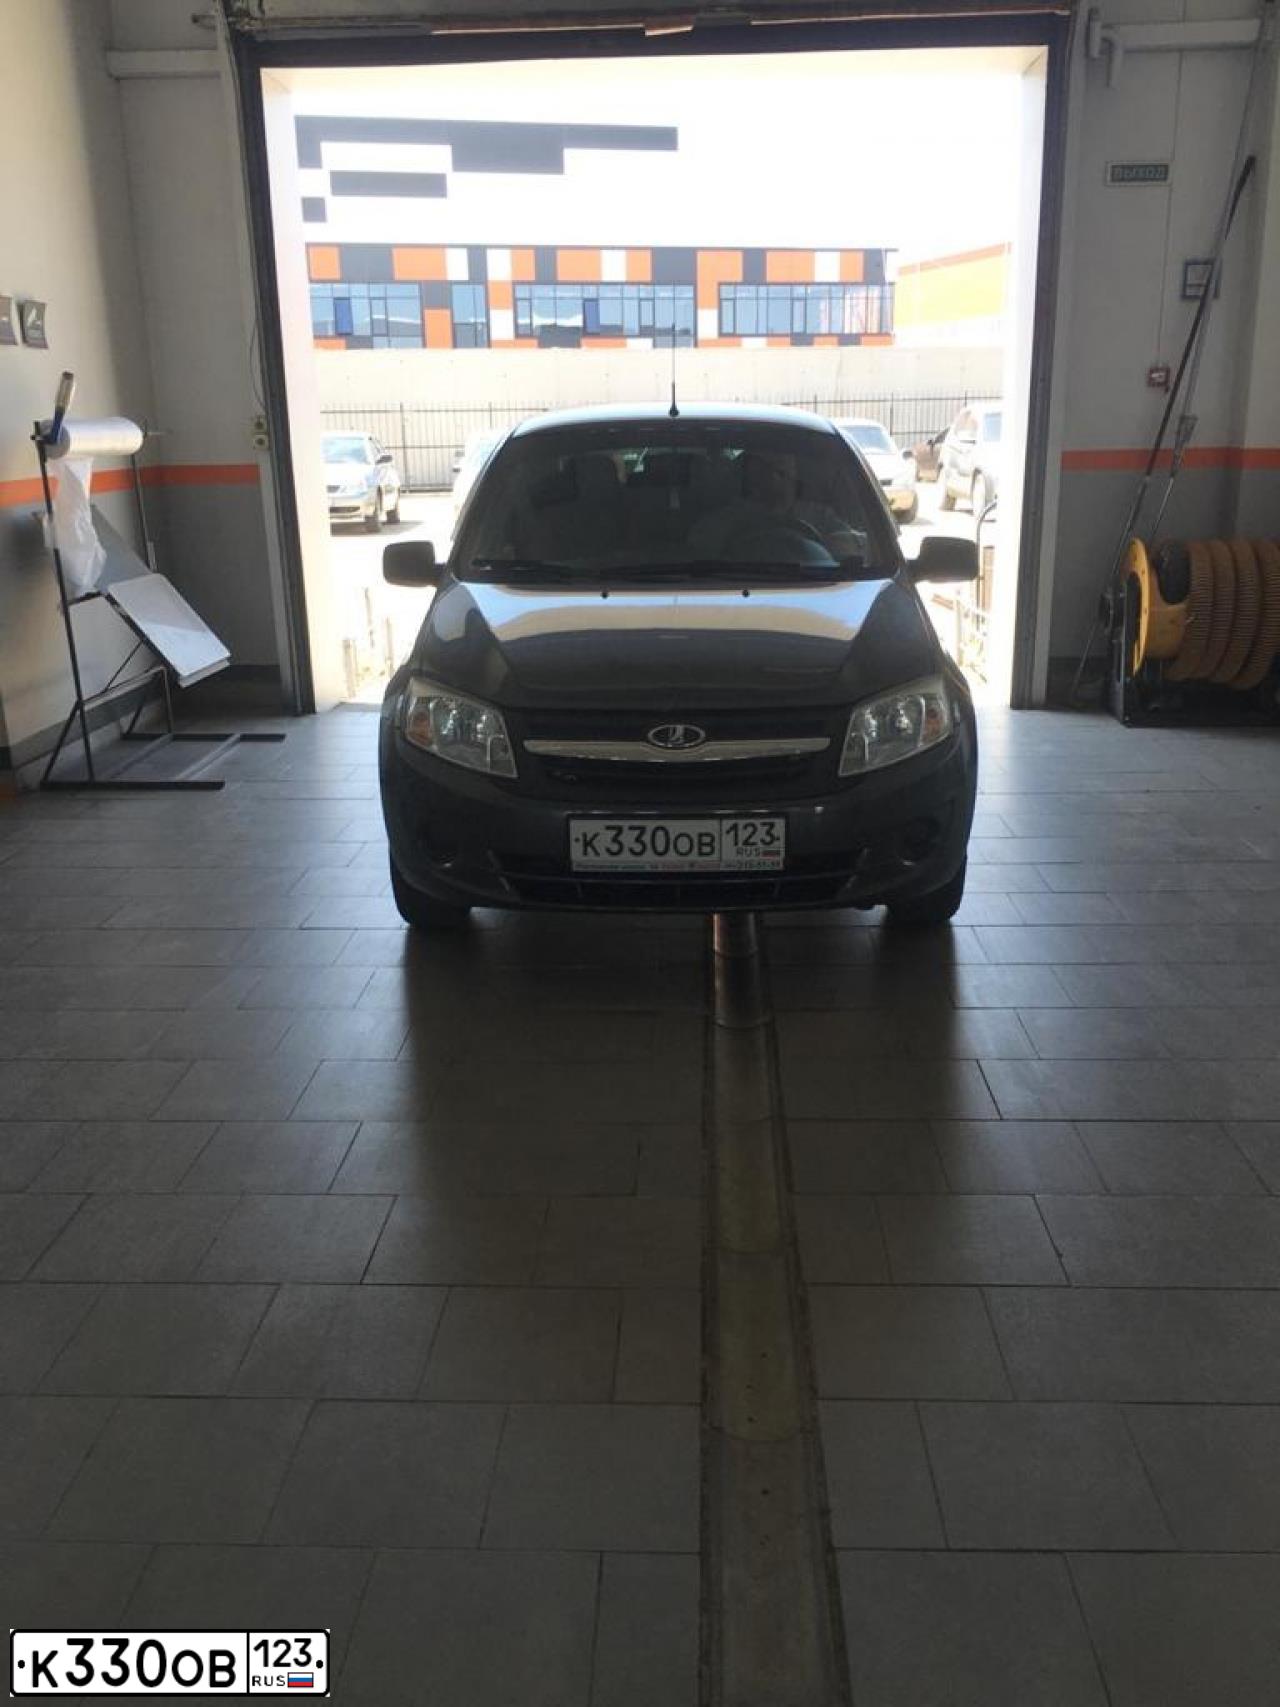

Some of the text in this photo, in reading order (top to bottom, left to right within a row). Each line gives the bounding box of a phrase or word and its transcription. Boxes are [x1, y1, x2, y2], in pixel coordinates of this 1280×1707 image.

[581, 821, 776, 857] К330ОВ 123
[736, 847, 761, 858] RUS
